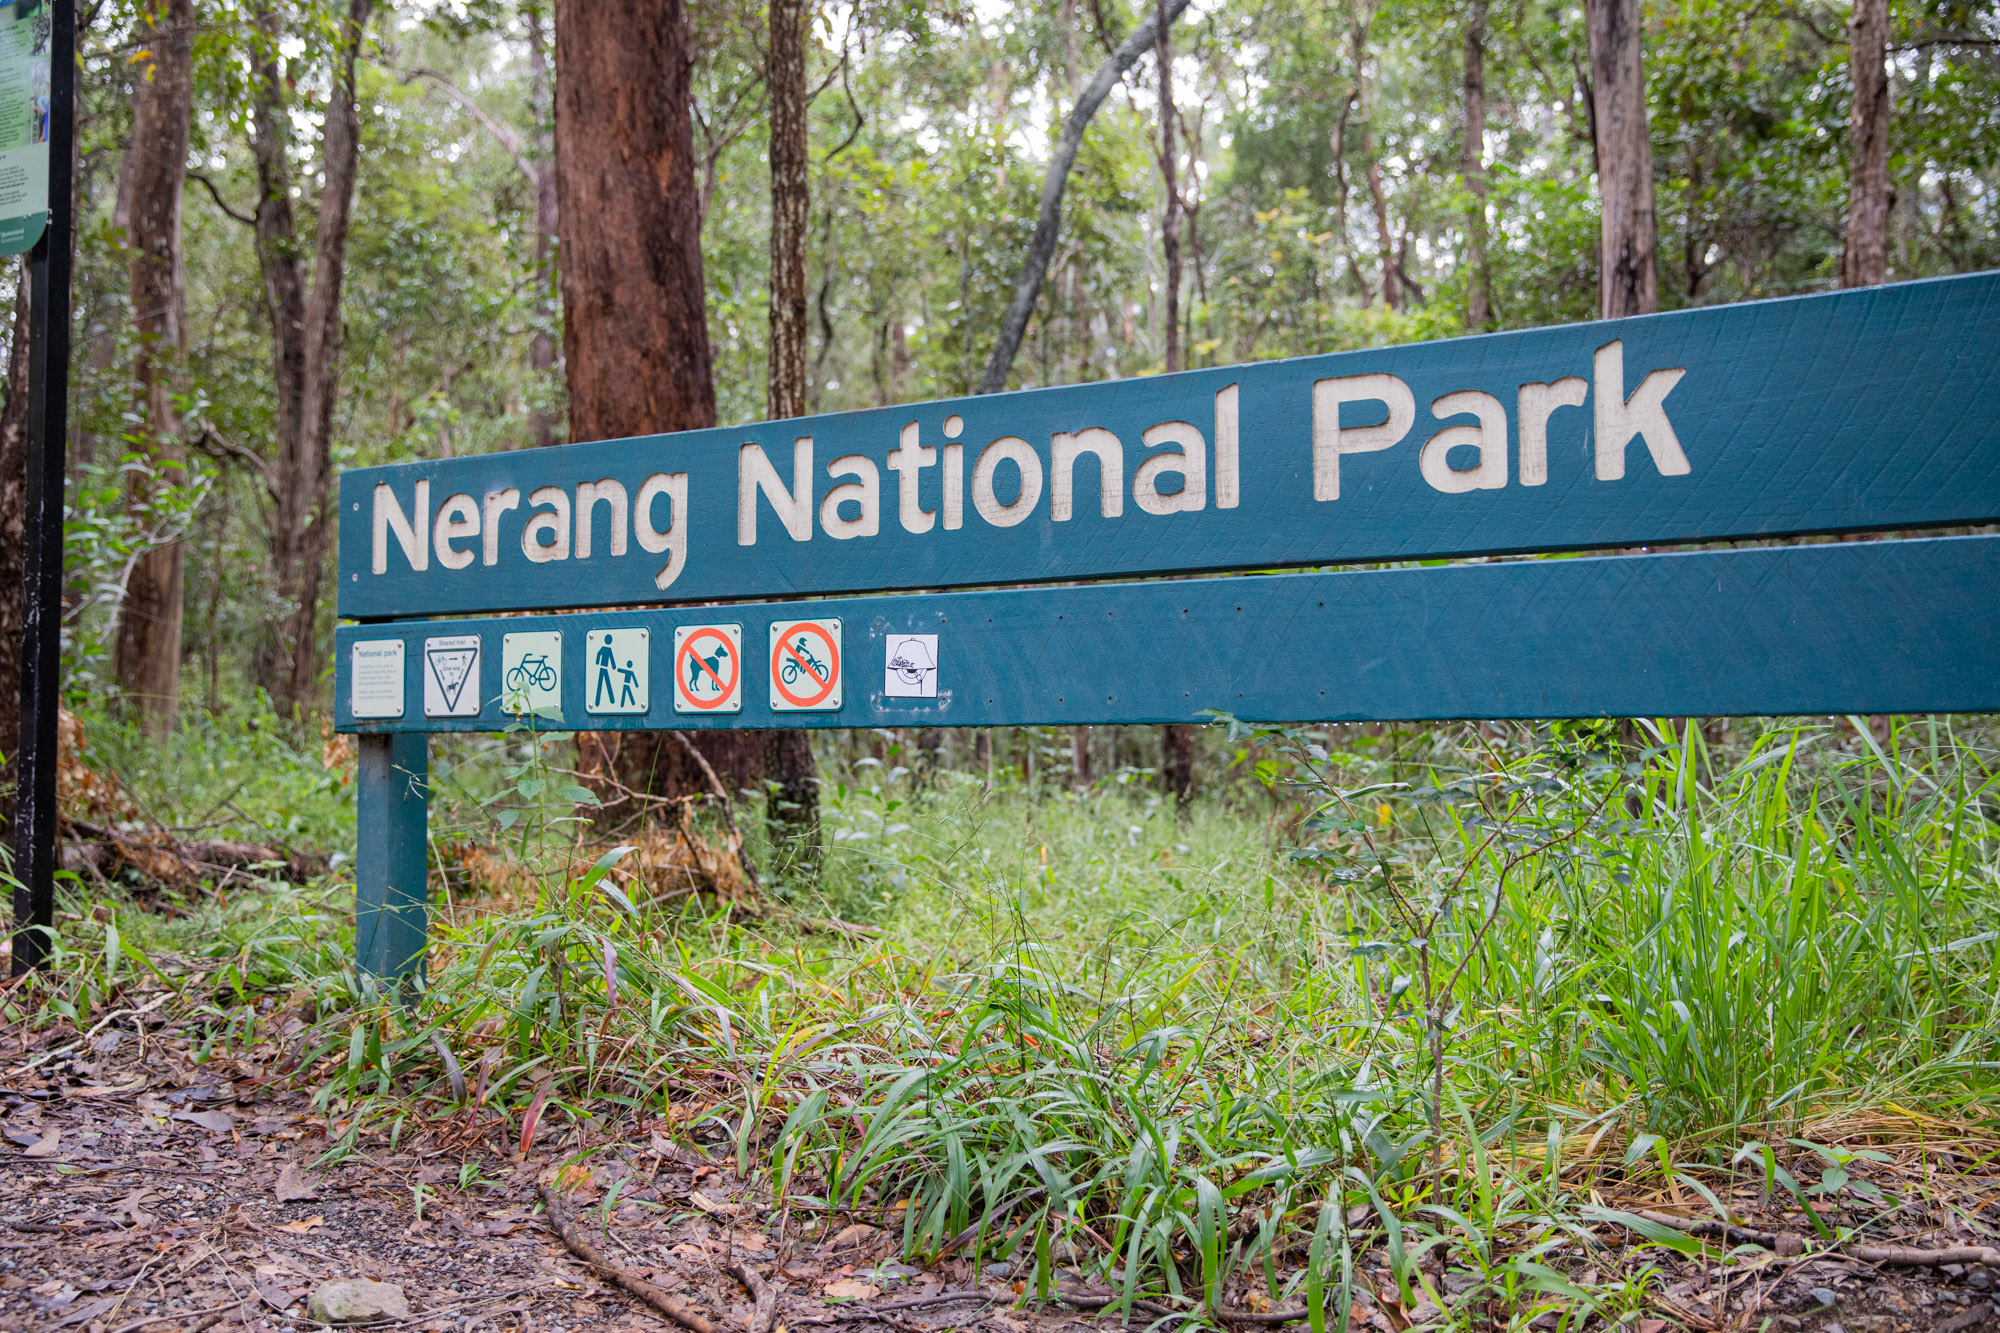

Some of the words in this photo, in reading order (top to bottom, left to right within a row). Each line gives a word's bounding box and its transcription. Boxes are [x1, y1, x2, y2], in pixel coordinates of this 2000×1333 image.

[372, 471, 688, 590] Nerang
[737, 383, 1239, 546] National
[1312, 338, 1691, 502] Park
[358, 650, 382, 658] National
[384, 649, 397, 659] park
